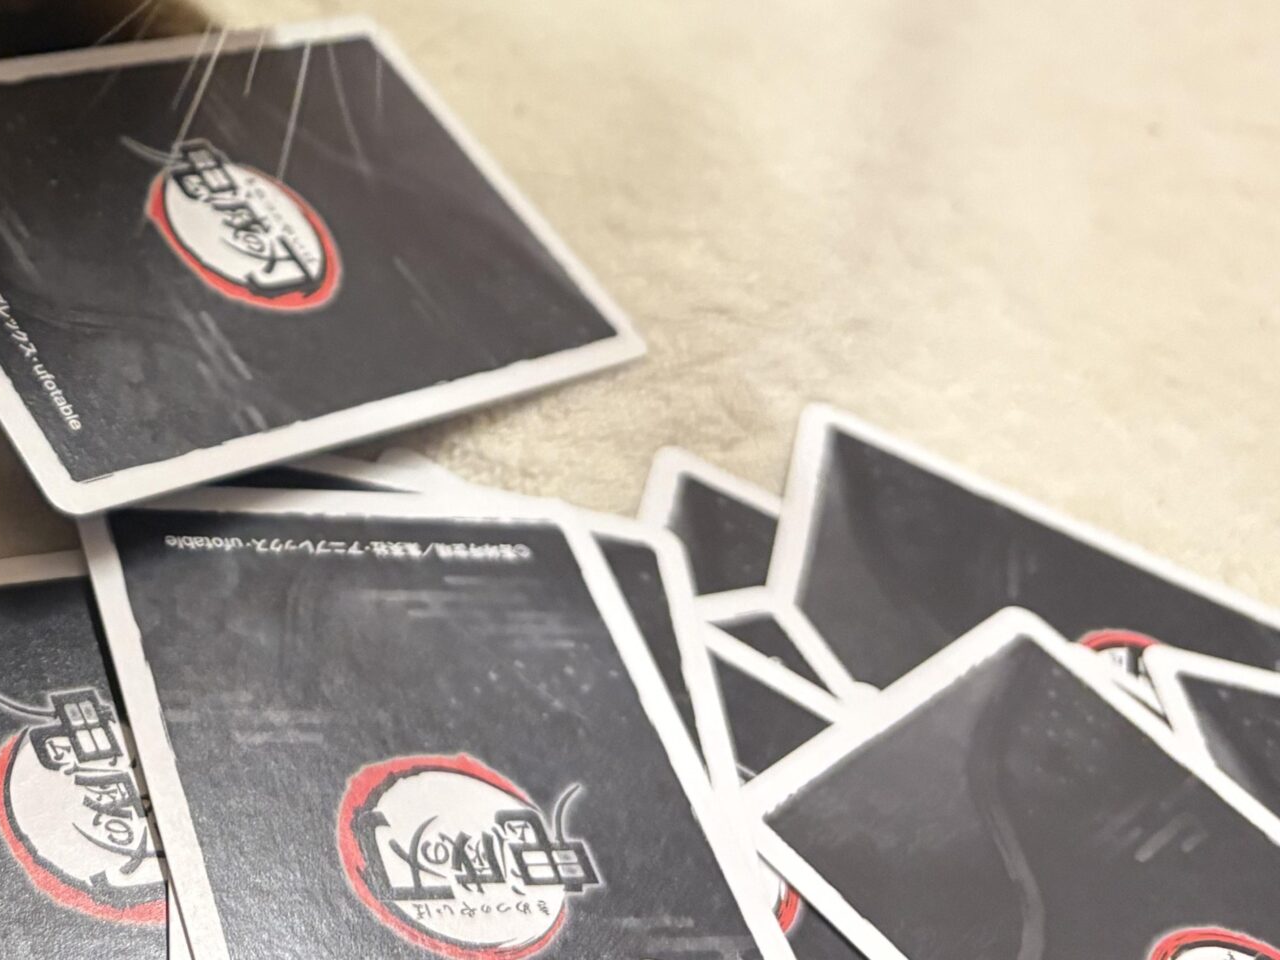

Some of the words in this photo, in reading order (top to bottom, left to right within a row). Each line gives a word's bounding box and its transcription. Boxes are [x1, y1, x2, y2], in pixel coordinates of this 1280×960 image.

[363, 783, 601, 901] 鬼滅の刃
[410, 901, 550, 922] きめつのやいば
